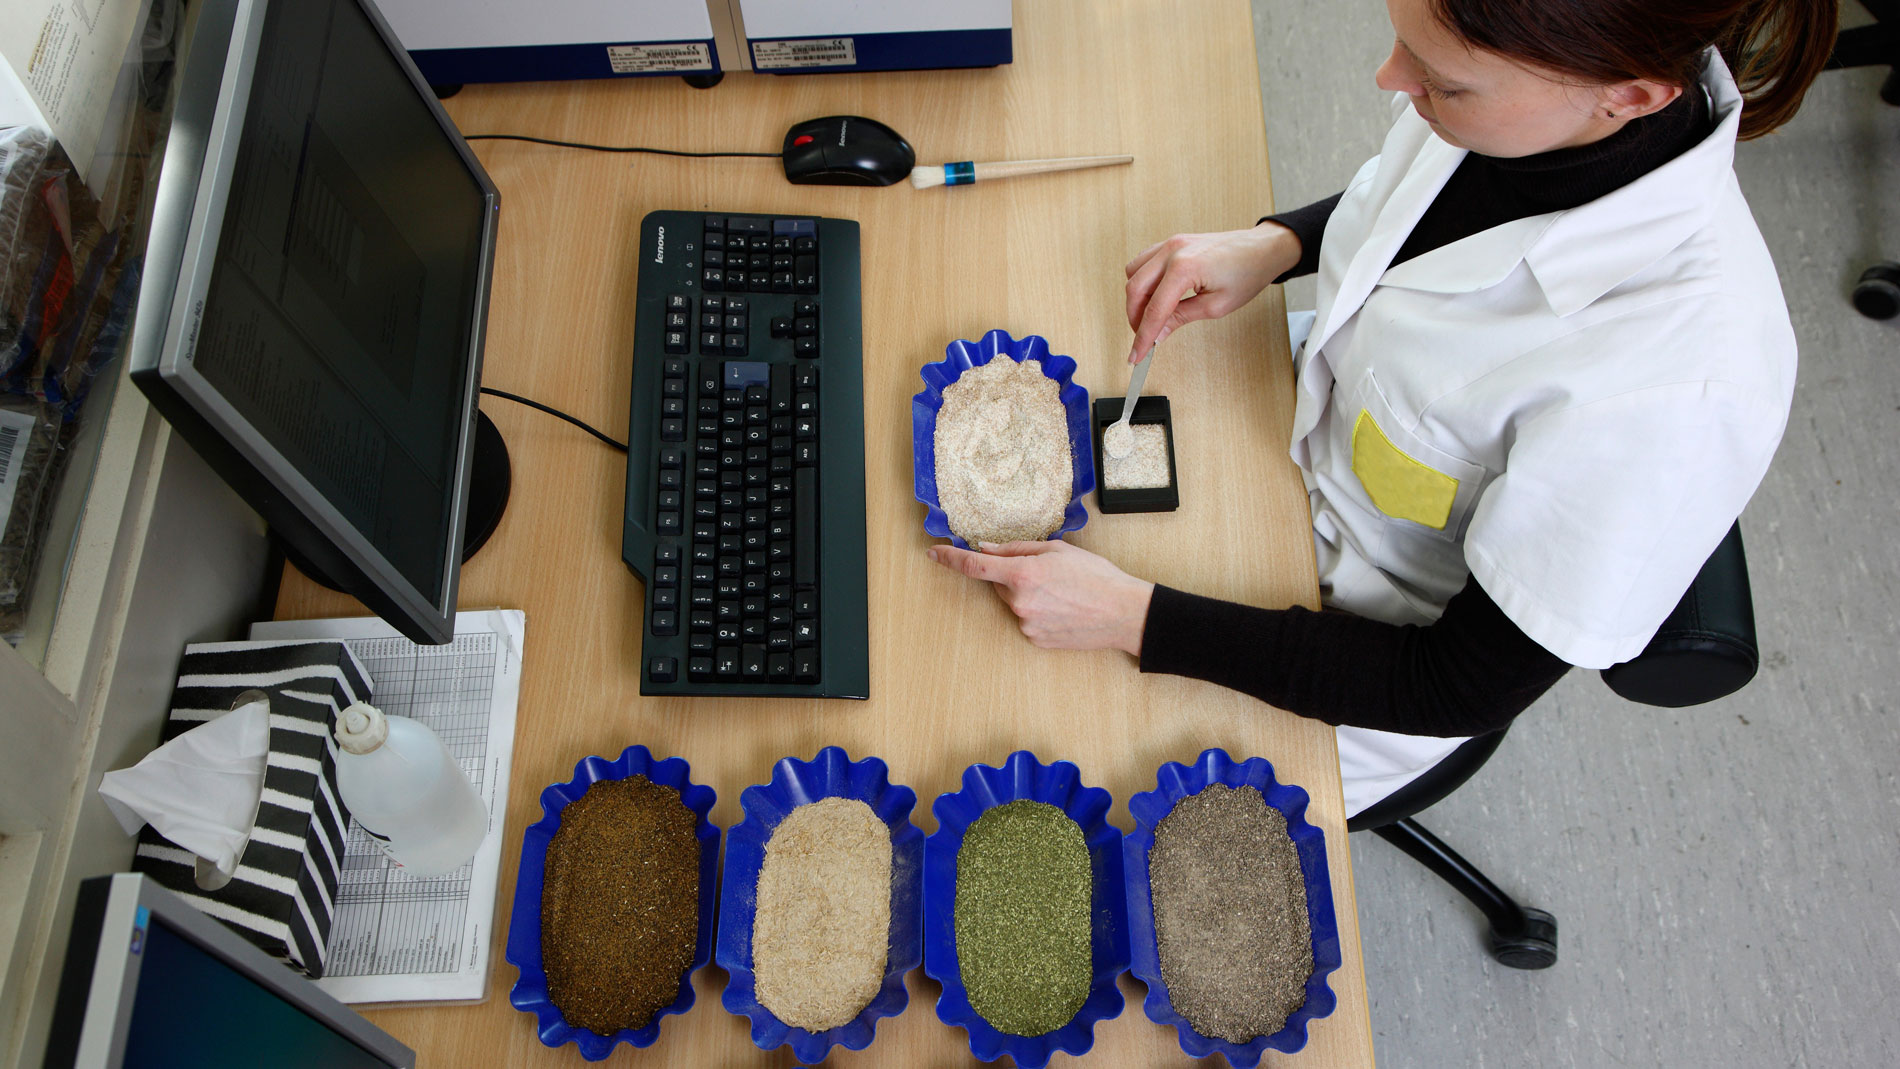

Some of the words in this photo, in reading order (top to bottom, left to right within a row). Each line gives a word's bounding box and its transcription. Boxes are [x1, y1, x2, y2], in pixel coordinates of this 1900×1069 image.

[838, 120, 848, 147] lenovo
[655, 226, 665, 264] lenovo
[724, 456, 733, 464] O
[721, 606, 729, 615] W
[719, 629, 728, 637] Q
